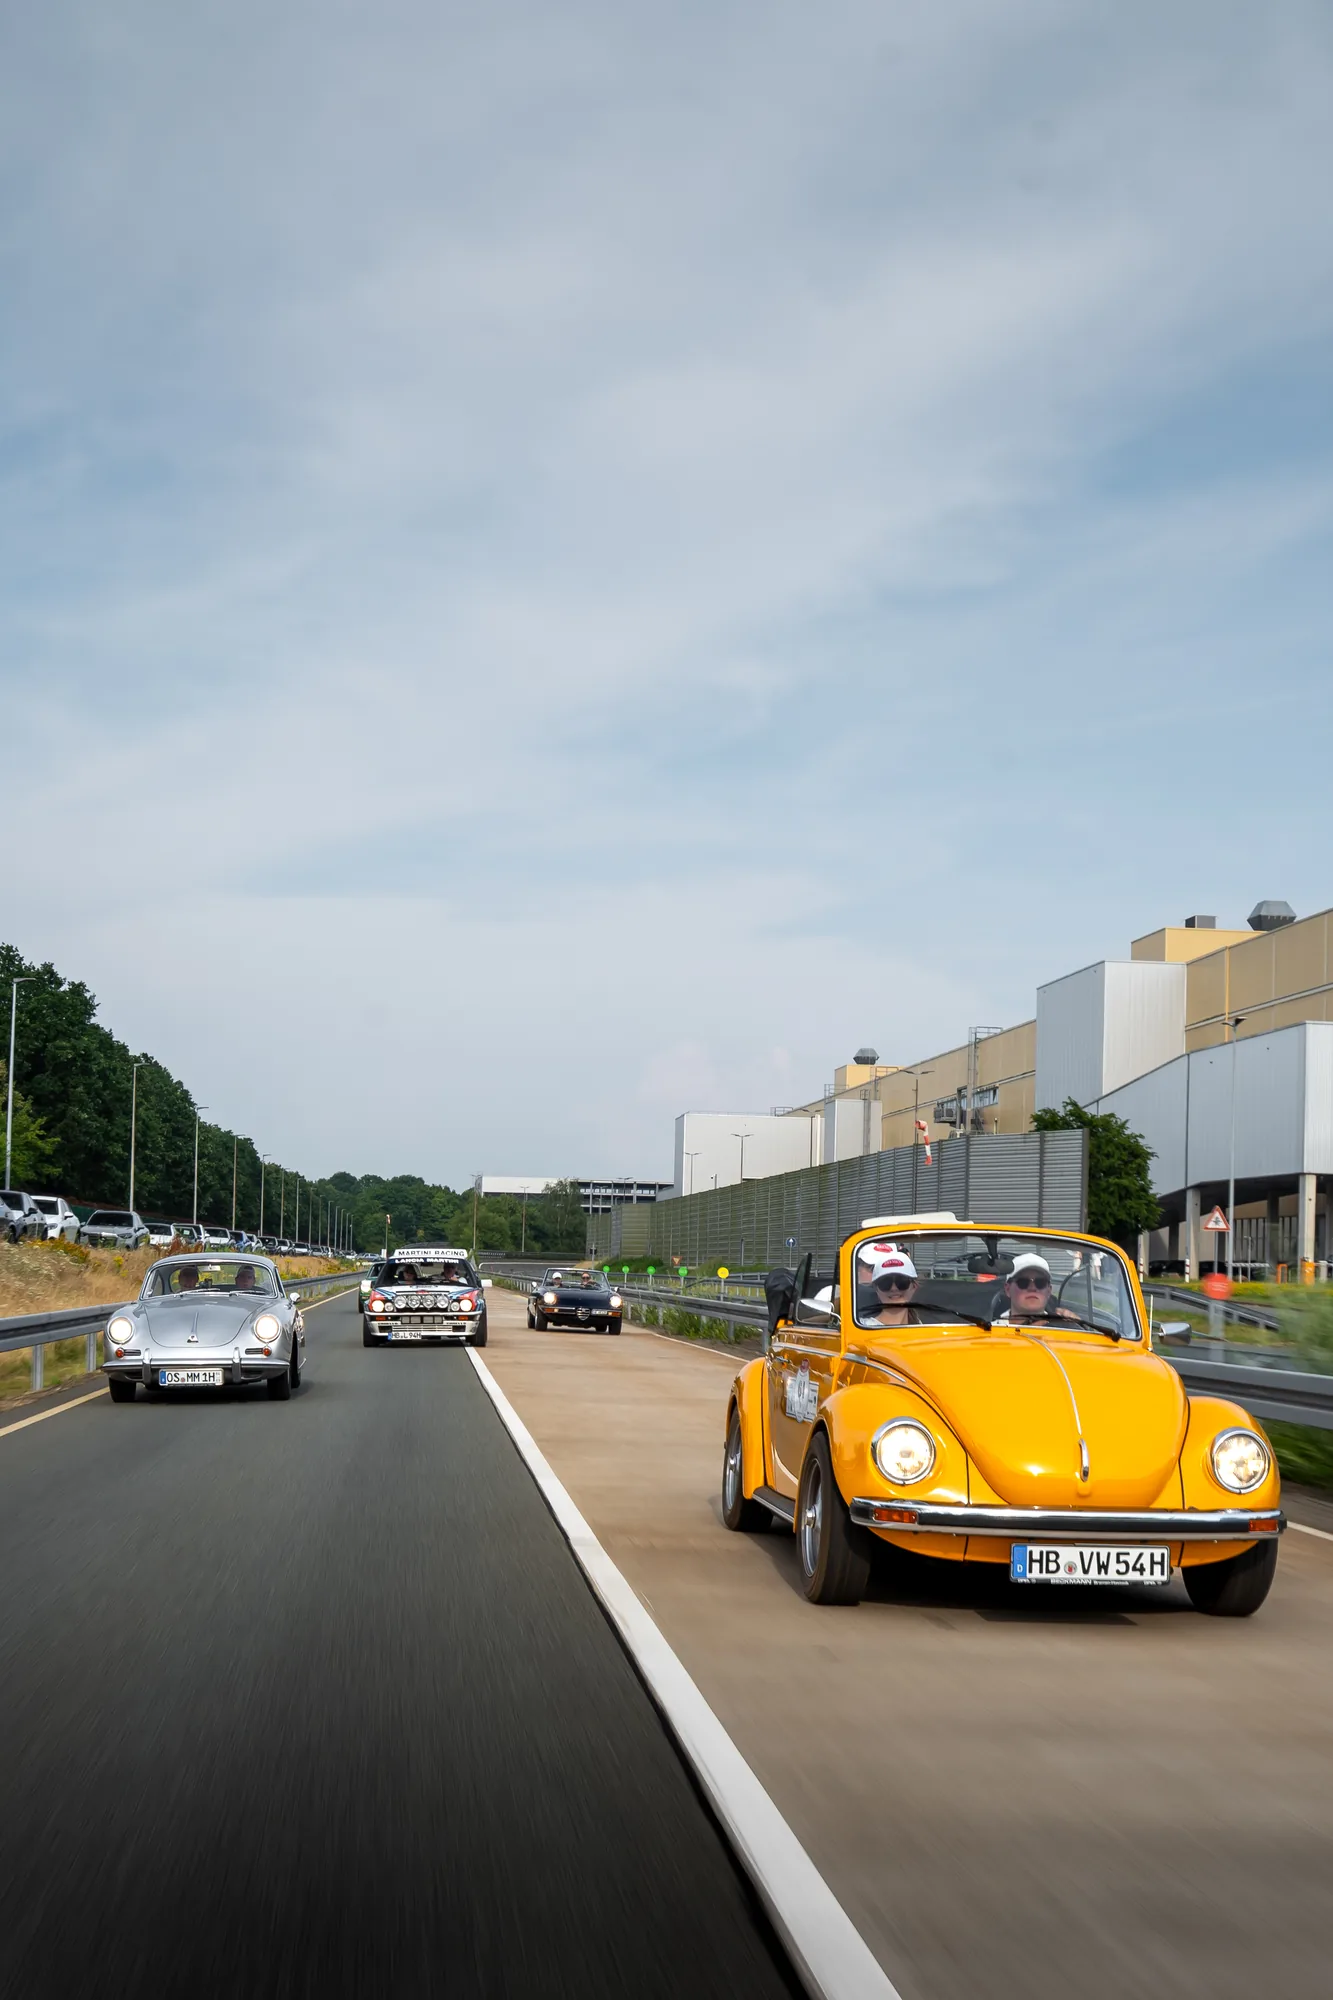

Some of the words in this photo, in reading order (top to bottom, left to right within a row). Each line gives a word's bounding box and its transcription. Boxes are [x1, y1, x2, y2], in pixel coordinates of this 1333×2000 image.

[167, 1372, 180, 1383] OS
[186, 1372, 200, 1383] MM
[202, 1372, 215, 1383] 1H
[1017, 1564, 1023, 1573] D
[1028, 1550, 1061, 1575] HB
[1079, 1551, 1111, 1576] VW
[1116, 1552, 1166, 1577] 54H
